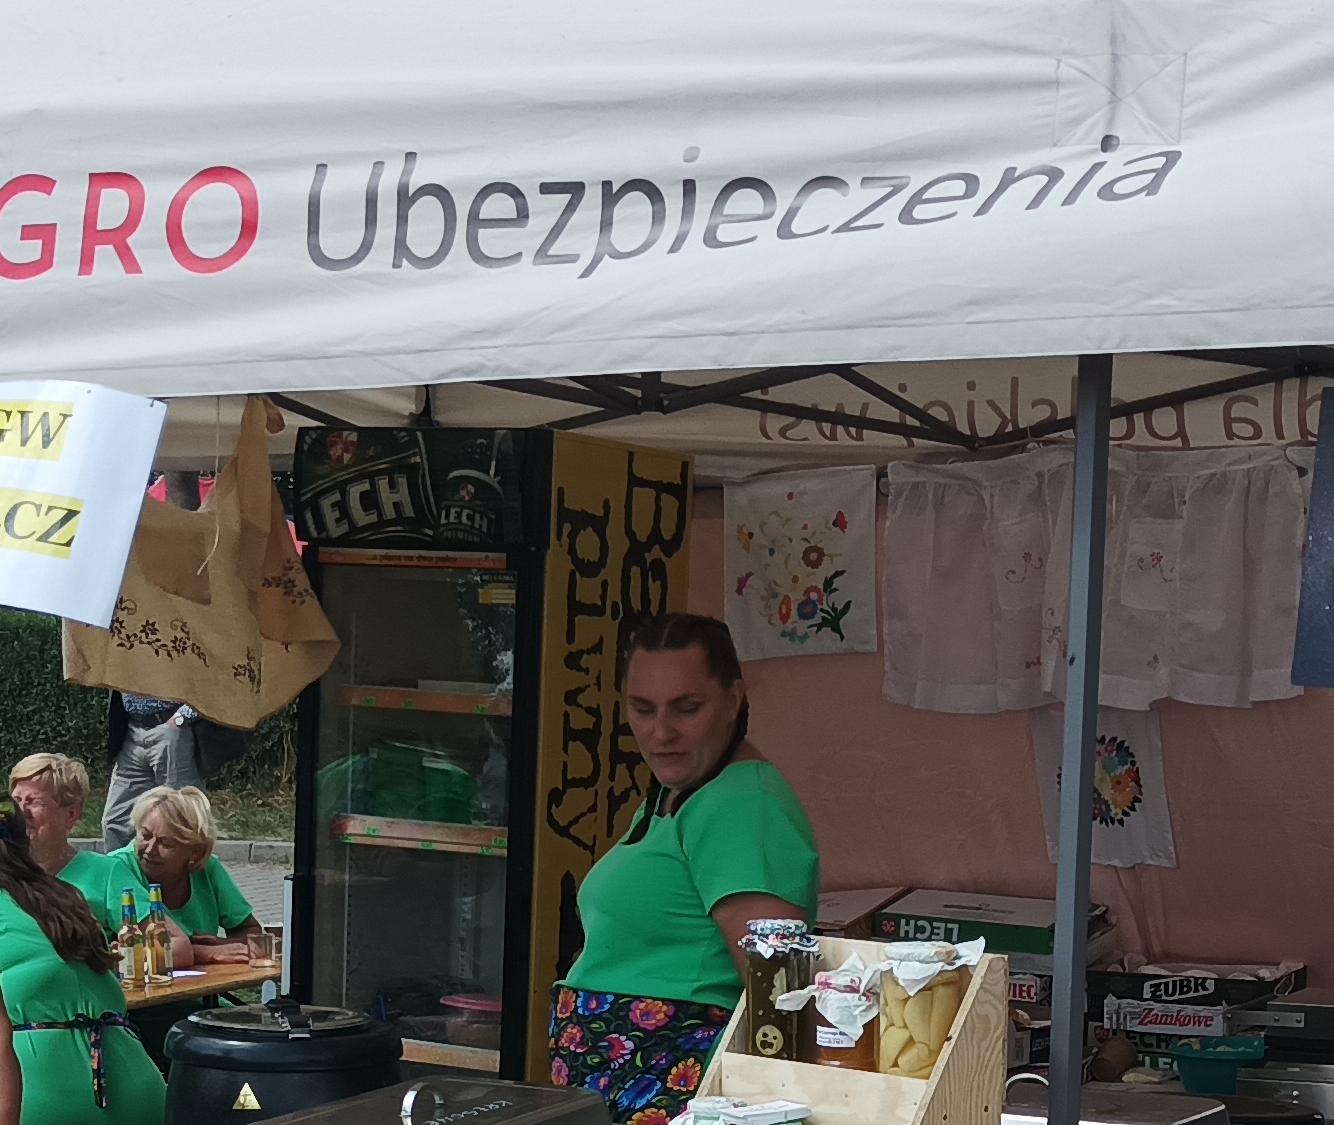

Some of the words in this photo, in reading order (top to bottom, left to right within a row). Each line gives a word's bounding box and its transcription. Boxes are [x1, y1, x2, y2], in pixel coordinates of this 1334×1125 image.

[305, 134, 1182, 278] Ubezpieczenia
[304, 474, 416, 540] LECH
[440, 506, 488, 533] LECH
[547, 486, 619, 853] piwny
[607, 451, 690, 838] Bak
[899, 918, 960, 942] LECH
